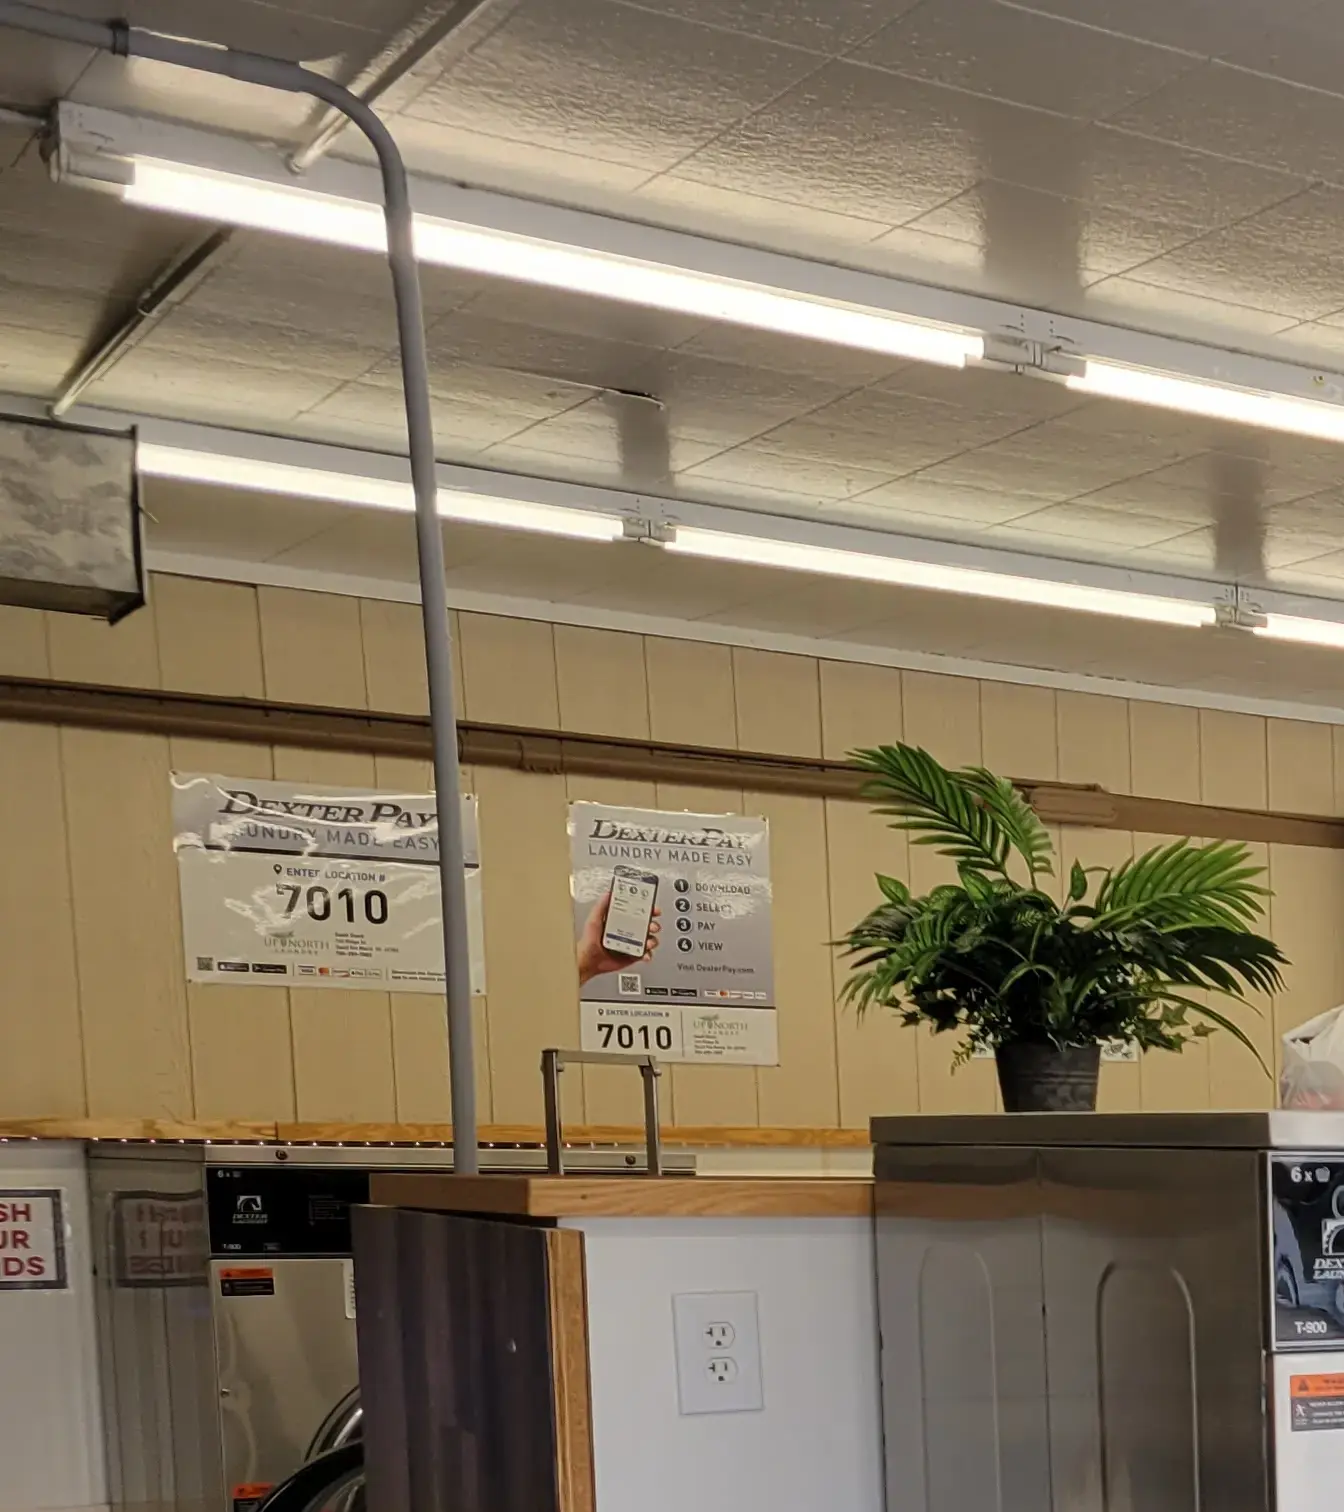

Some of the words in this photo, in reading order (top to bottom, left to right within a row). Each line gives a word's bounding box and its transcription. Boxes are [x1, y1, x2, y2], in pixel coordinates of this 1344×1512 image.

[588, 844, 661, 860] LAUNDRY
[669, 848, 709, 863] MADE
[717, 853, 753, 867] EASY
[325, 870, 375, 881] LOCATION
[696, 883, 750, 895] DOWNLOAD
[276, 883, 388, 924] 7010
[696, 903, 733, 913] SELE
[698, 922, 715, 931] PAY
[698, 942, 723, 951] VIEW
[597, 1023, 672, 1050] 7010
